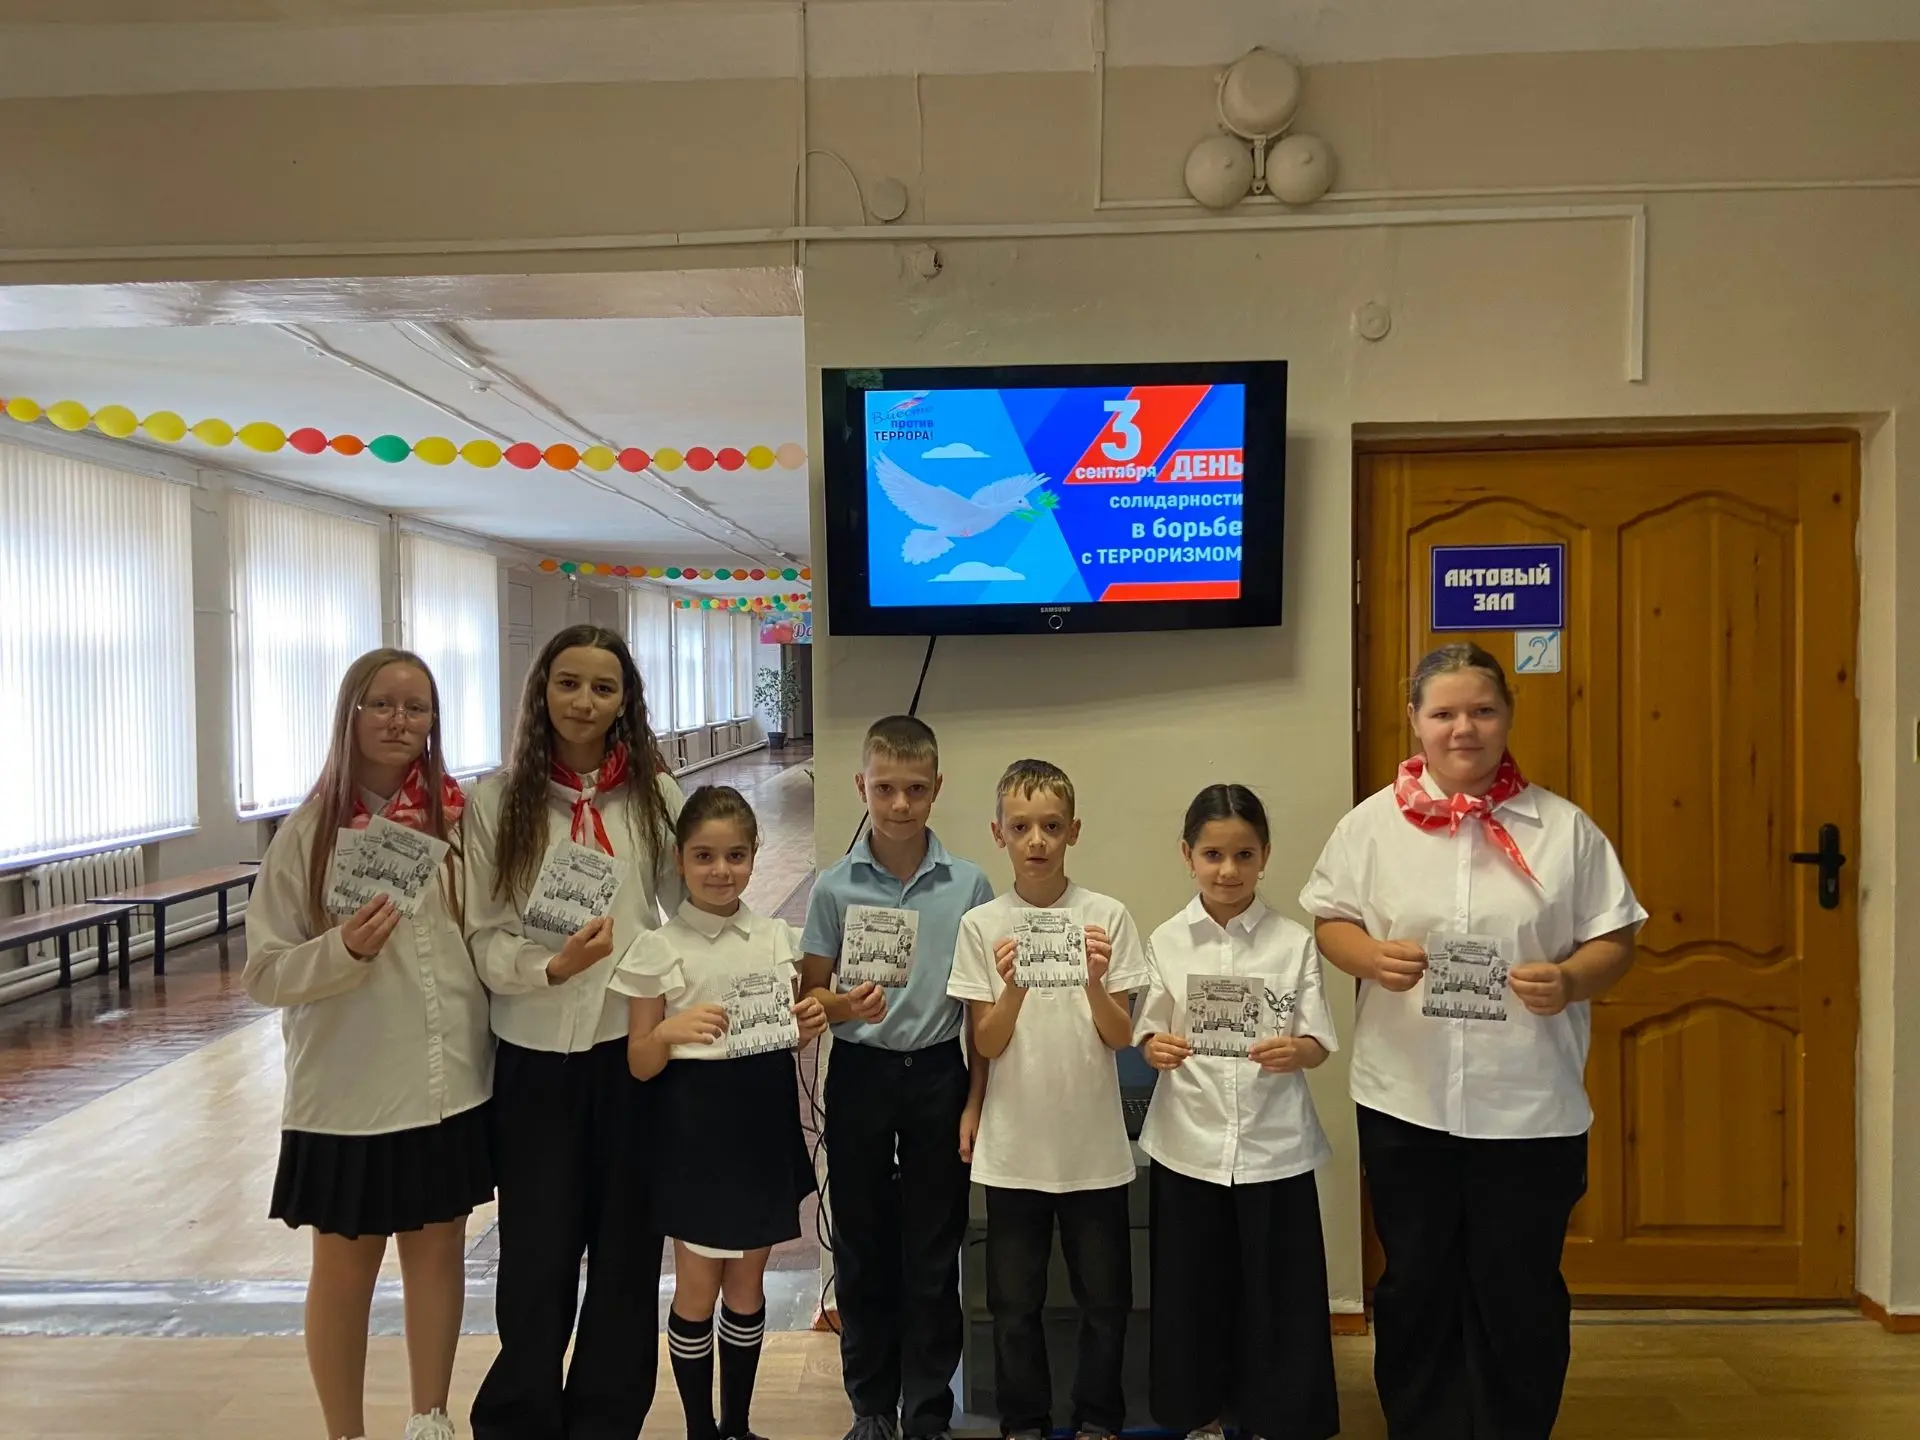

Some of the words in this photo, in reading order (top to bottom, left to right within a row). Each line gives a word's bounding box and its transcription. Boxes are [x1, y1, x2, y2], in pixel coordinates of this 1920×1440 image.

[891, 419, 934, 430] против
[1100, 399, 1142, 462] 3
[874, 429, 934, 441] ТЕРРОРА!
[1074, 464, 1157, 481] сентября
[1170, 453, 1244, 481] ДЕНЬ
[1109, 493, 1244, 510] солидарности
[1131, 523, 1146, 538] в
[1152, 517, 1243, 542] борьбе
[1081, 551, 1092, 564] с
[1097, 545, 1243, 565] ТЕРРОРИЗМОМ
[1444, 563, 1551, 587] АКТОВЫЙ
[1473, 592, 1515, 611] ЗАЛ
